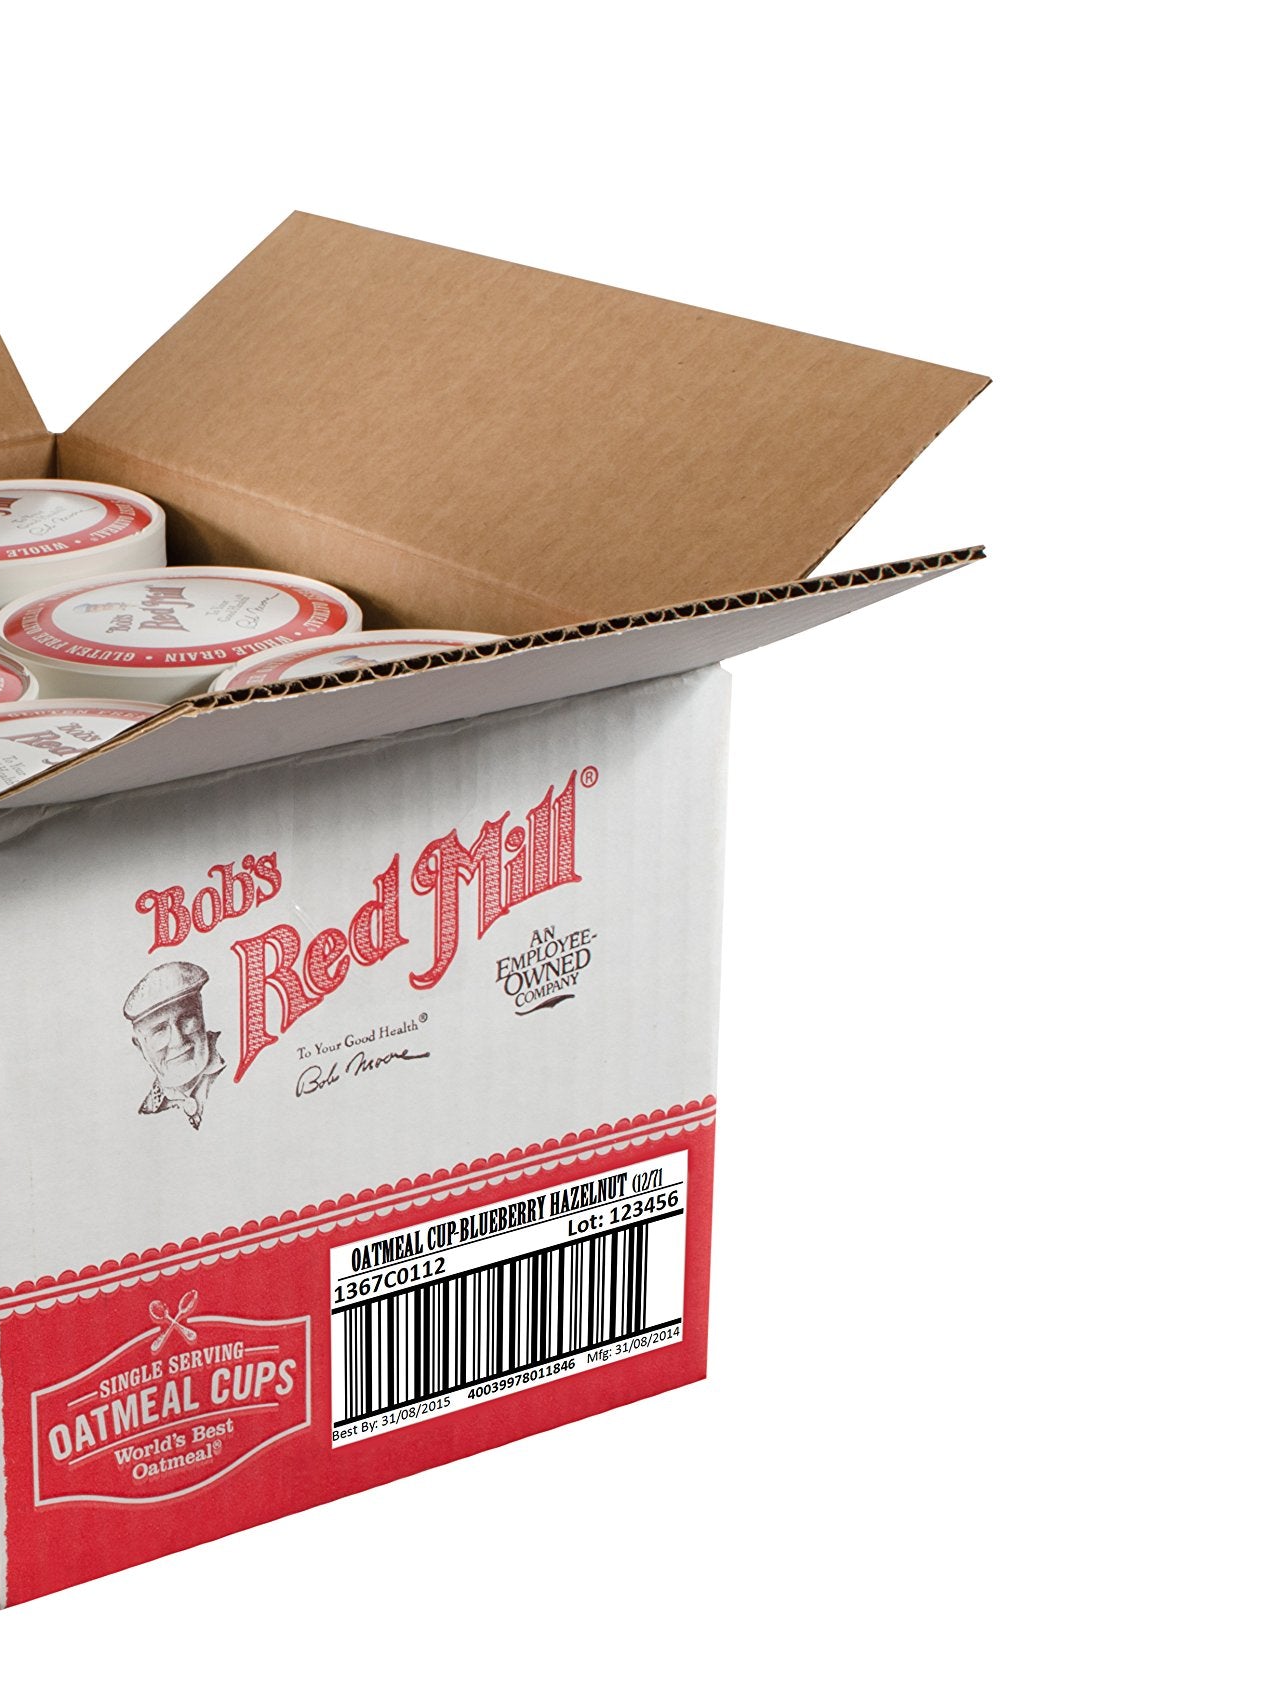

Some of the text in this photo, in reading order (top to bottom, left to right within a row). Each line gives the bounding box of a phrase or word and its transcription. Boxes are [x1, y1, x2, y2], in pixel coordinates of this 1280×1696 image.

[6, 542, 69, 559] WHOLE
[32, 632, 68, 650] FREE
[65, 644, 136, 662] GLUTEN
[165, 635, 293, 663] WHOLE GRAIN
[135, 851, 282, 954] Bob's
[495, 928, 598, 983] EMPLOYEE-
[529, 925, 556, 948] AN
[230, 853, 410, 1083] Red
[503, 947, 592, 997] OWNED
[514, 971, 580, 1008] COMPANY
[297, 1046, 312, 1060] To
[314, 1041, 342, 1056] Your
[344, 1030, 376, 1048] Good
[351, 1228, 424, 1272] OATMEAL
[426, 1195, 547, 1248] CUP-BLUEBERRY
[549, 1172, 628, 1218] HAZELNUT
[568, 1190, 679, 1237] Lot: 123456
[333, 1256, 447, 1304] 1367C0112
[586, 1326, 680, 1364] Mfg: 31/08/2014
[99, 1342, 244, 1399] SINGLE SERVING
[467, 1358, 576, 1400] 40039978011846
[48, 1359, 297, 1461] OATMEAL CUPS
[332, 1396, 451, 1441] Best By: 31/08/2015
[114, 1418, 234, 1465] World's Best
